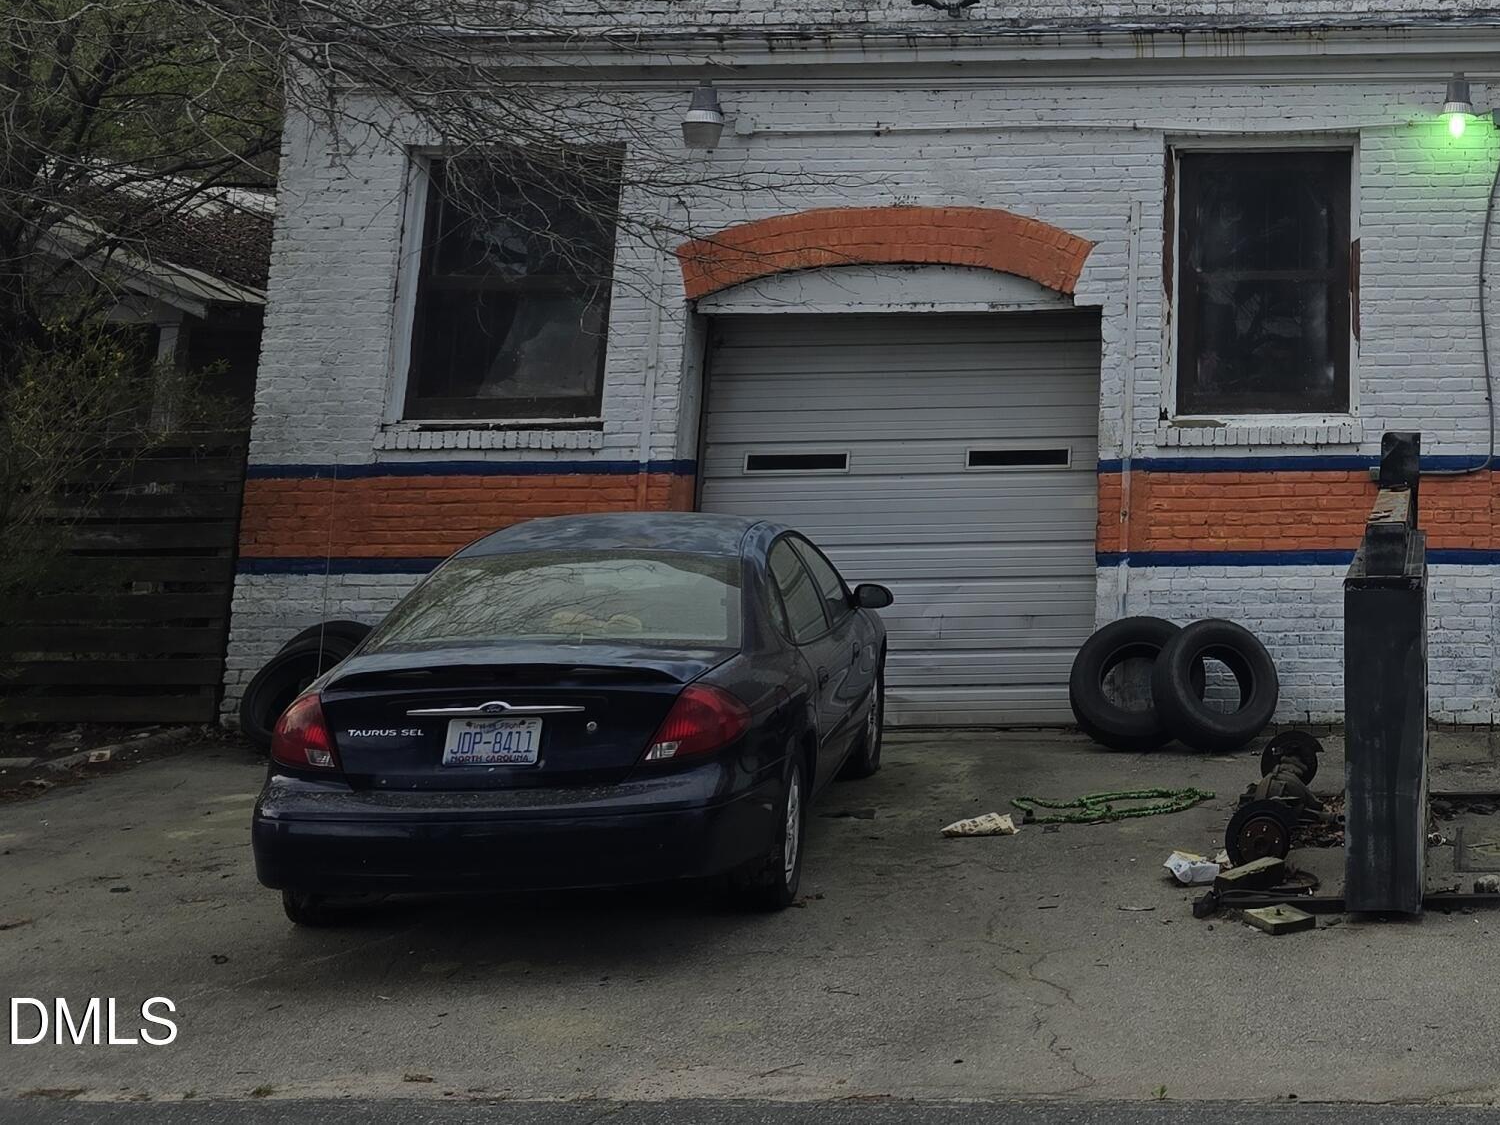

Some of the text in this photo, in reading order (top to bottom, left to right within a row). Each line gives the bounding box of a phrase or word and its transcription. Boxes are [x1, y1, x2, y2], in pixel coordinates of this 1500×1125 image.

[347, 728, 425, 737] TAURUS SEL
[450, 731, 533, 755] JDP-8411
[450, 755, 482, 763] NORTH
